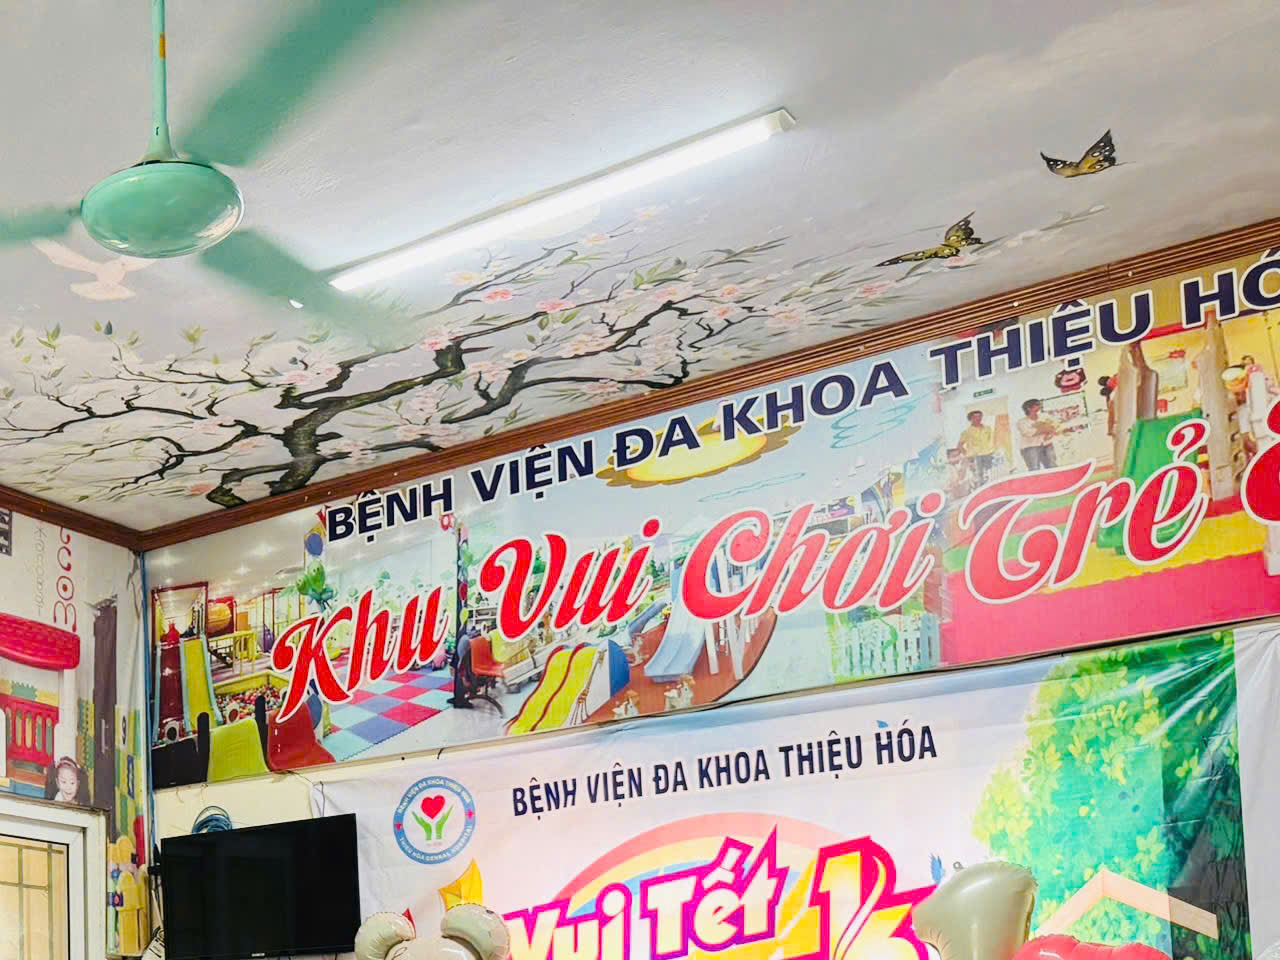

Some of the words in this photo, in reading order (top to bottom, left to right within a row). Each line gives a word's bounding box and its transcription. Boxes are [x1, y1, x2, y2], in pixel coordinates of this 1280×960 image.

[327, 478, 453, 544] BỆNH
[472, 438, 595, 501] VIỆN
[613, 415, 701, 471] ĐA
[722, 361, 910, 441] KHOA
[930, 296, 1153, 387] THIỆU
[271, 586, 450, 723] Khu
[480, 519, 662, 641] Vui
[681, 490, 947, 618] Chơi
[958, 419, 1210, 604] Trẻ
[513, 776, 577, 821] BỆNH
[587, 762, 644, 809] VIỆN
[653, 760, 688, 796] ĐA
[697, 747, 771, 789] KHOA
[779, 730, 863, 783] THIỆU
[876, 720, 938, 763] HÓA
[646, 852, 780, 960] Tết
